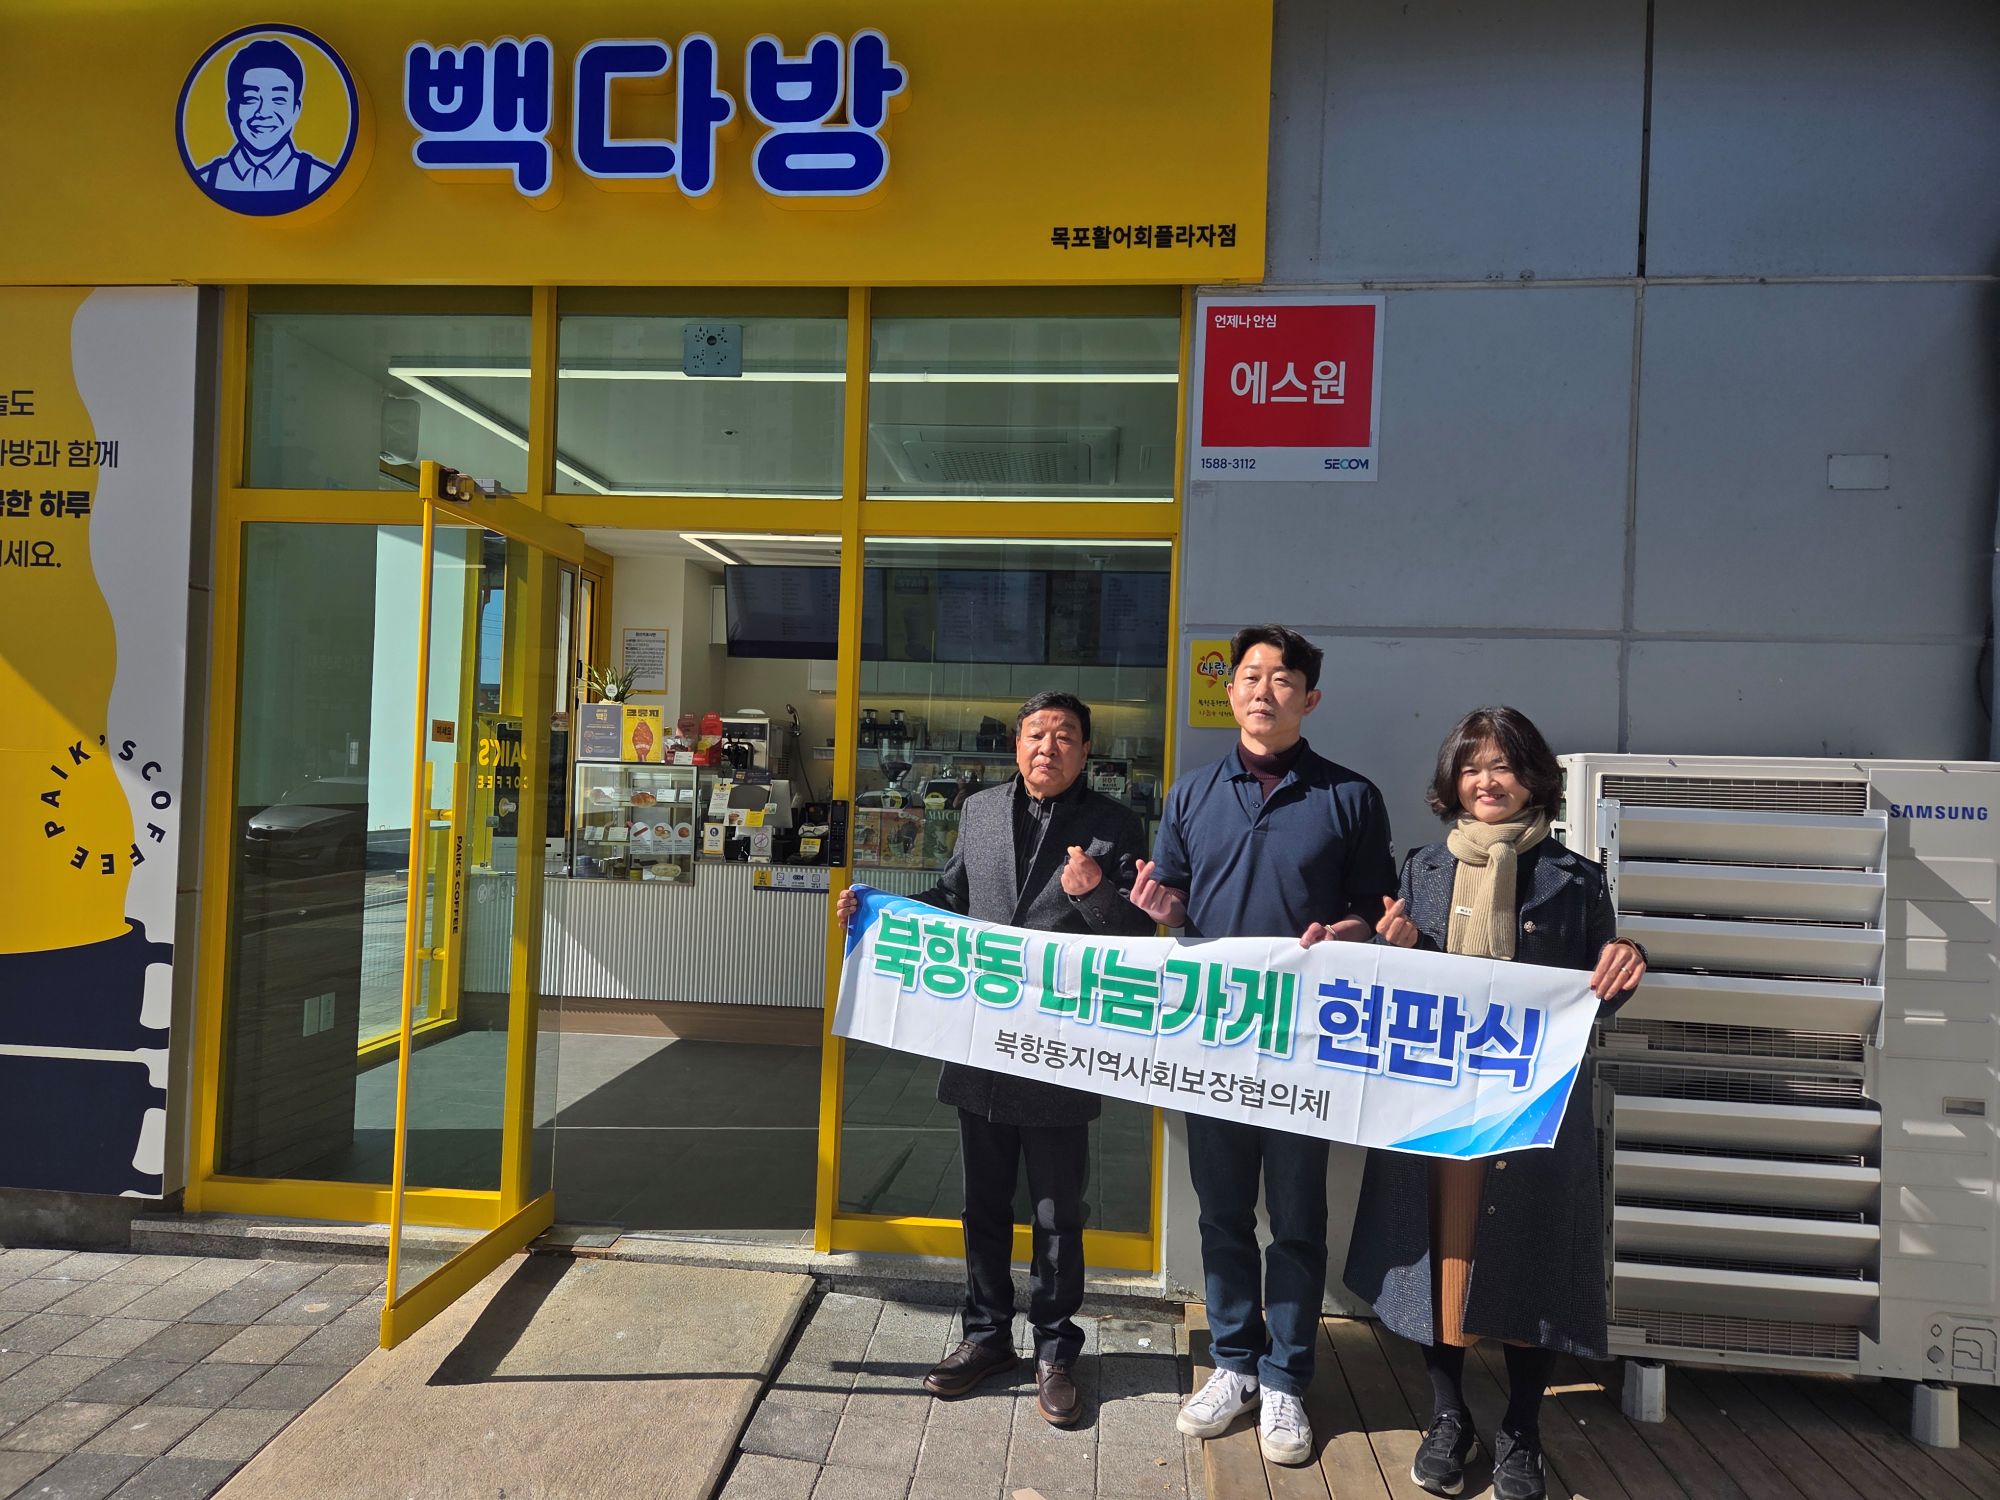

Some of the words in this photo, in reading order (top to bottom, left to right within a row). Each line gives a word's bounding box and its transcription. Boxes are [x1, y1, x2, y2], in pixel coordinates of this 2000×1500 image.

[404, 30, 908, 197] 빽다방
[1050, 223, 1237, 250] 목포활어회플라자점
[1214, 314, 1251, 329] 언제나
[1253, 314, 1277, 328] 안심
[1230, 360, 1346, 405] 에스원
[67, 440, 119, 468] 함께
[1201, 458, 1256, 470] 1588-3112
[1324, 458, 1369, 470] SECOM
[40, 490, 91, 519] 하루
[70, 761, 172, 875] COFFEE
[1890, 804, 1988, 821] SAMSUNG
[452, 881, 460, 935] COFFEE
[873, 911, 1026, 1007] 북항동
[1037, 941, 1299, 1057] 나눔가게
[1315, 977, 1542, 1089] 현판식
[993, 1028, 1332, 1122] 북항동지역사회보장협의체
